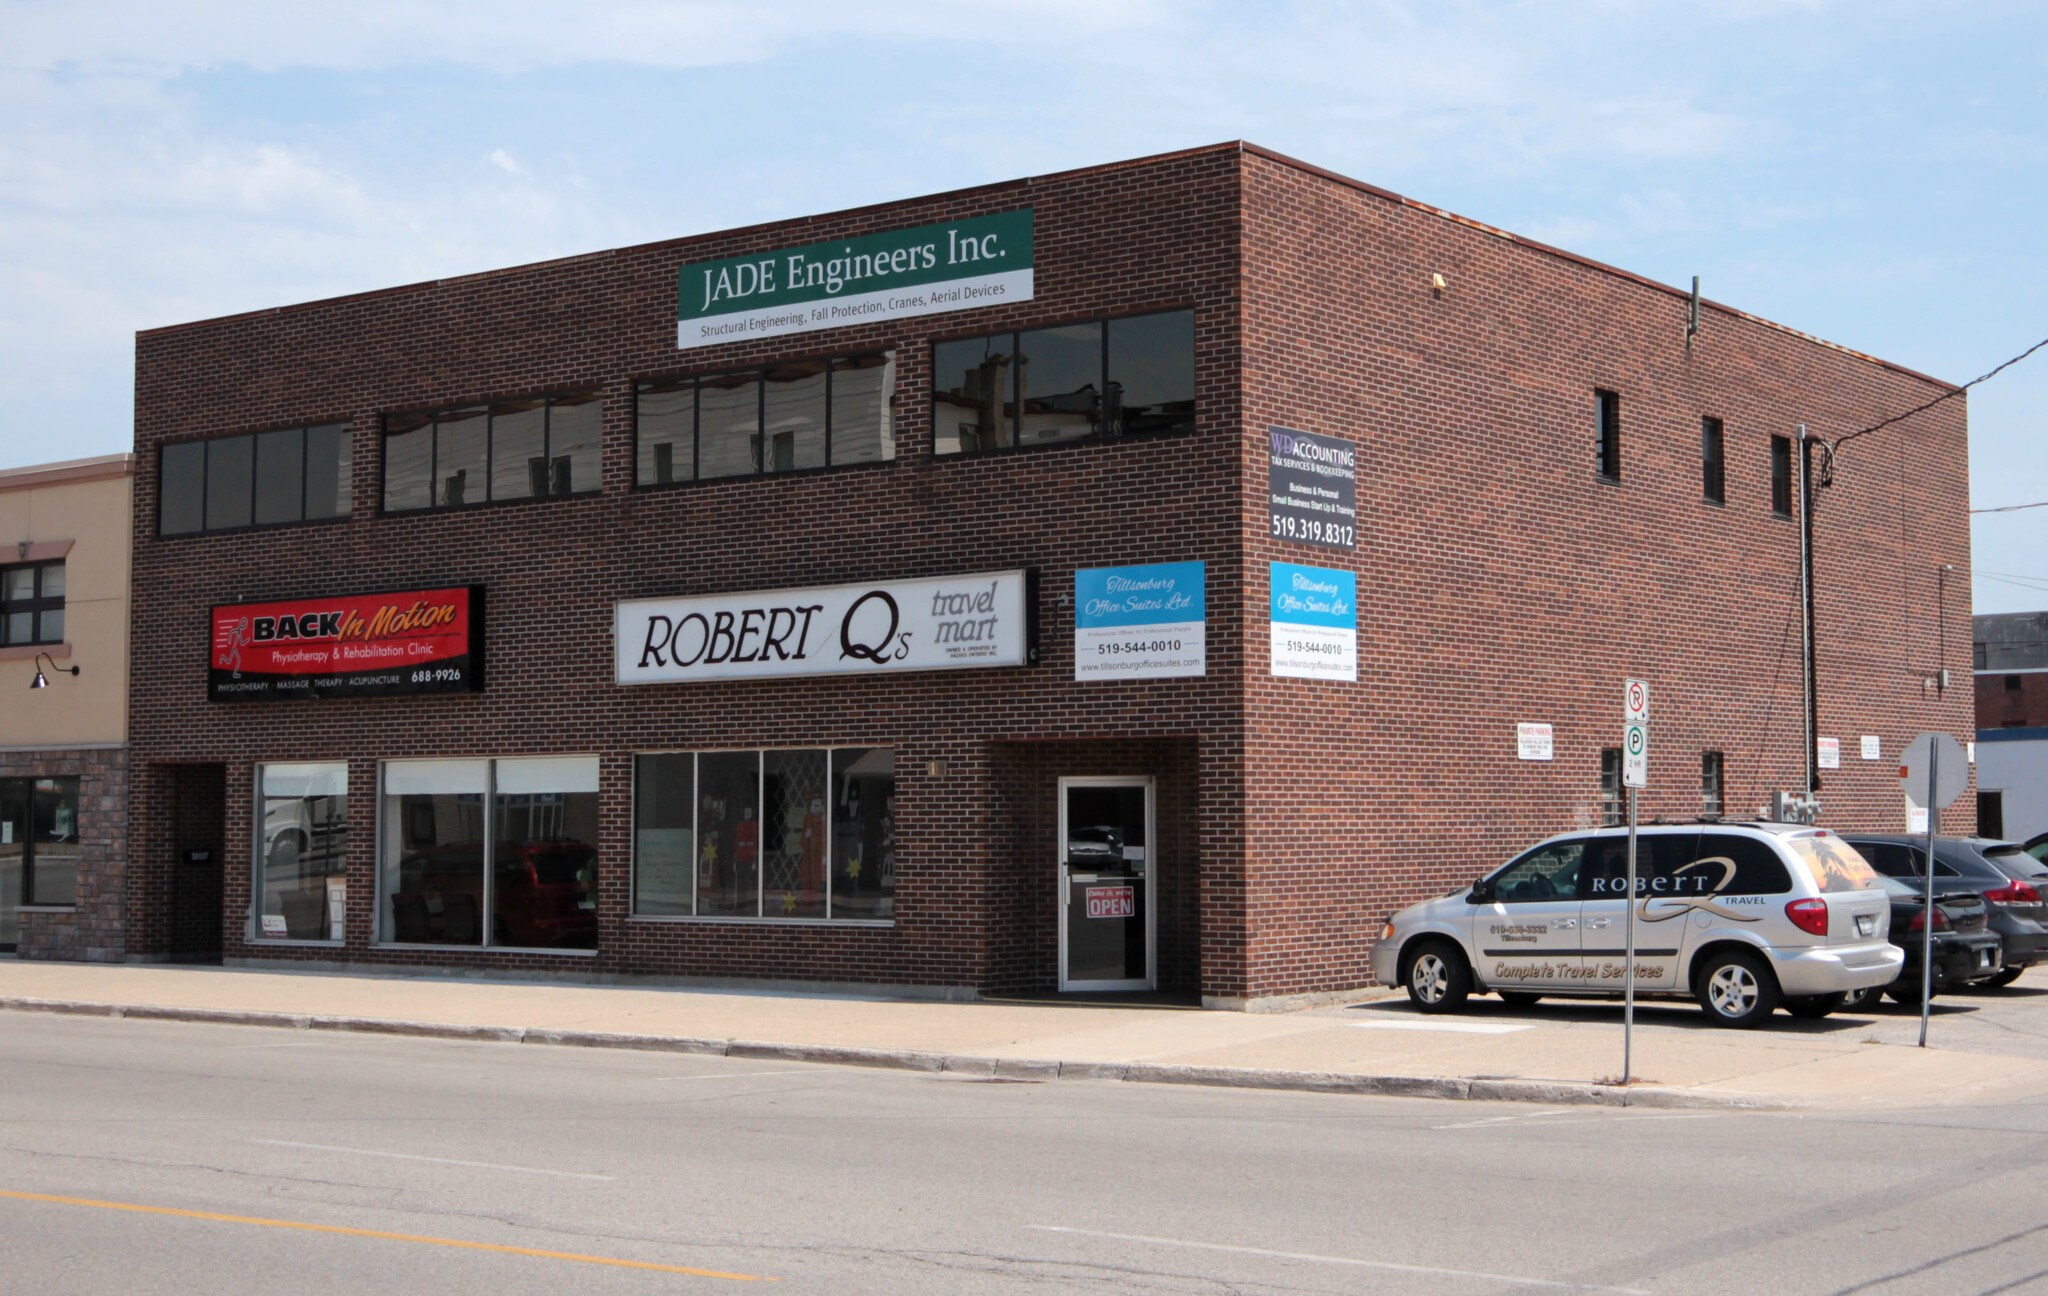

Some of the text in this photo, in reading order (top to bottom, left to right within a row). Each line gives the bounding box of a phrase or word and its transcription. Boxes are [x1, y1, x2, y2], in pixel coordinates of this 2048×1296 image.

[701, 229, 1006, 312] JADE Engineers Inc.
[701, 283, 1005, 337] Structural Engineering, Fall Protection, Cranes, Aerial Devices
[1272, 456, 1282, 466] TAX
[1284, 458, 1310, 472] SERVICES
[1316, 464, 1355, 479] BOOKKEEPING
[1290, 482, 1312, 495] Business
[1318, 488, 1339, 499] Personal
[1272, 494, 1287, 505] Small
[1288, 497, 1310, 509] Business
[1336, 505, 1355, 518] Training
[1273, 515, 1354, 546] 519.319.8312
[1107, 575, 1175, 594] Tillsonburg
[1292, 573, 1338, 597] Tillsonburg
[931, 581, 998, 617] travel
[1085, 593, 1194, 617] Office Suites Ltd.
[1277, 594, 1350, 616] Office Suites Ltd.
[253, 600, 456, 641] BACK In Motion
[934, 616, 998, 644] mart
[637, 604, 823, 668] ROBERT
[1098, 639, 1181, 655] 519-544-0010
[272, 642, 433, 666] Physiotherapy & Rehabilitation Clinic
[1287, 639, 1342, 656] 519-544-0010
[411, 669, 461, 682] 688-9926
[1081, 658, 1200, 673] www.tillsonburgofficesuites.com
[218, 675, 400, 692] PHYSIOTHERAPY MASSAGE THERAPY ACUPUNCTURE
[1632, 733, 1639, 749] P
[1090, 898, 1131, 915] OPEN
[1725, 896, 1766, 905] TRAVEL
[1495, 961, 1664, 981] Complete Travel Serices
